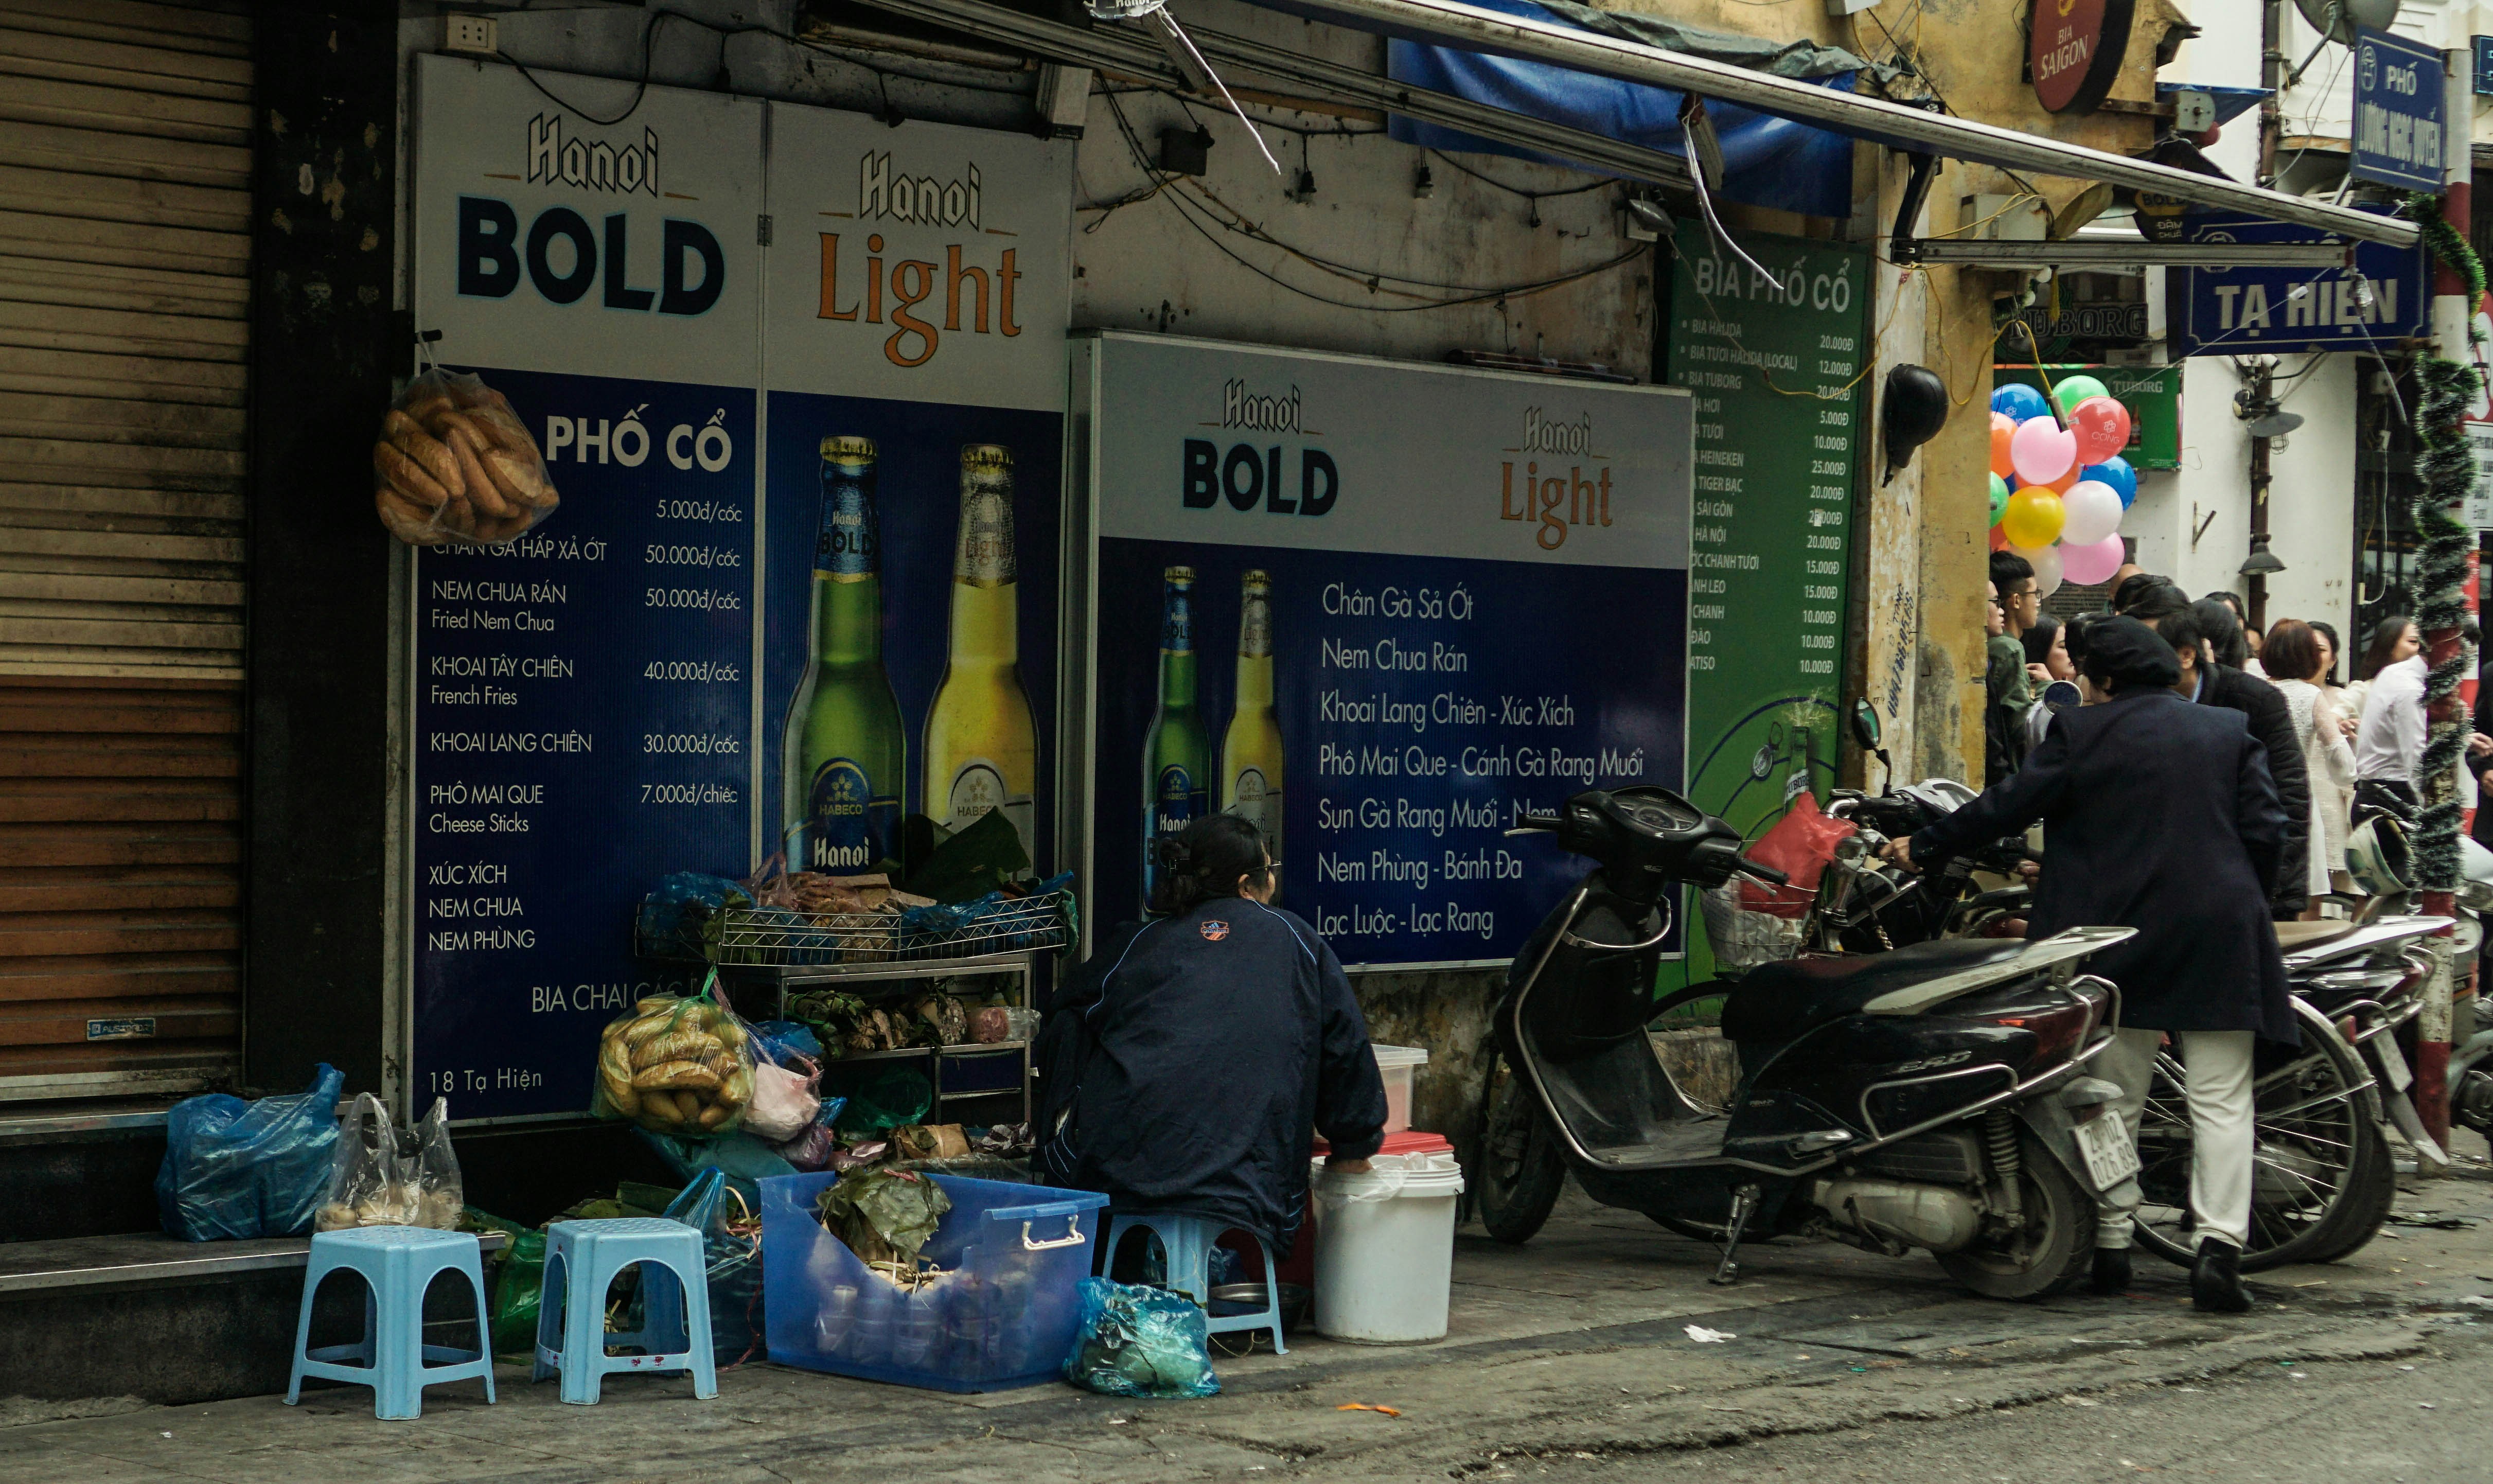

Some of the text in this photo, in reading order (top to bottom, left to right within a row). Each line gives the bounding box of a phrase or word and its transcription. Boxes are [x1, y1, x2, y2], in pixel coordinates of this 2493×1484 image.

[2058, 25, 2072, 45] BIA
[2041, 34, 2089, 80] SAIGON
[2385, 62, 2417, 95] PHỐ
[528, 112, 658, 198] Hanoi
[860, 149, 981, 232] Hanoi
[458, 196, 724, 315] BOLD
[1698, 256, 1850, 313] BIA PHỐ CỔ
[817, 232, 1022, 367] Light
[2215, 269, 2397, 337] TẠ HIỆN
[1692, 319, 1741, 337] BIA HALIDA
[1820, 335, 1853, 351] 20.000Đ
[1690, 345, 1705, 360] BIA
[1764, 352, 1797, 372] (LOCAL)
[1819, 360, 1852, 376] 12.000Đ
[1689, 371, 1741, 390] BIA TUBORG
[2113, 381, 2163, 392] TUBORG
[1224, 378, 1300, 434] Hanoi
[1820, 411, 1848, 426] 5.000Đ
[546, 404, 732, 472] PHỐ CỔ
[1524, 407, 1590, 457] Hanoi
[1815, 435, 1847, 451] 10.000Đ
[1701, 450, 1744, 467] HEINEKEN
[1812, 460, 1846, 475] 25.000Đ
[1183, 439, 1338, 516] BOLD
[1698, 476, 1743, 496] TIGER BẠC
[1811, 485, 1844, 500] 20.000Đ
[656, 499, 742, 523] 5.000đ/cốc
[1501, 462, 1613, 550] Light
[1697, 499, 1733, 517] SÀI GÒN
[522, 533, 607, 560] HẤP XẢ ỚT
[822, 531, 873, 555] BOLD
[1695, 525, 1726, 546] HÀ NỘI
[1807, 536, 1841, 550] 20.000Đ
[645, 545, 740, 568] 50.000đ/cốc
[1705, 553, 1737, 569] CHANH
[1806, 560, 1840, 575] 15.000Đ
[433, 579, 565, 603] NEM CHUA RÁN
[1709, 579, 1726, 593] LEO
[1805, 585, 1837, 599] 15.000Đ
[645, 588, 740, 611] 50.000đ/cốc
[1323, 581, 1473, 620] Chân Gà Sả Ớt
[433, 609, 554, 631] Fried Nem Chua
[1693, 605, 1724, 619] CHANH
[1803, 610, 1836, 624] 10.000Đ
[1690, 627, 1711, 644] ĐÀO
[1801, 635, 1834, 648] 10.000Đ
[432, 653, 572, 678] KHOAI TÂY CHIÊN
[1323, 638, 1466, 672] Nem Chua Rán
[1690, 656, 1715, 670] ATISO
[644, 661, 738, 683] 40.000đ/cốc
[1800, 660, 1833, 674] 10.000Đ
[432, 685, 517, 705] French Fries
[1322, 689, 1573, 732] Khoai Lang Chiên Xúc Xích
[431, 729, 591, 753] KHOAI LANG CHIÊN
[644, 734, 738, 756] 30.000đ/cốc
[1320, 742, 1643, 785] Phô Mai Que Cánh Gà Rang Muối
[430, 781, 543, 805] PHÔ MAI QUE
[642, 783, 737, 806] 7.000đ/chiếc
[819, 804, 862, 815] HABECO
[958, 806, 990, 816] HABEC
[1319, 798, 1353, 833] Sụn
[1360, 798, 1390, 828] Gà
[1398, 799, 1444, 837] Rang
[1451, 798, 1497, 828] Muối
[430, 812, 528, 833] Cheese Sticks
[814, 837, 869, 867] Hanoi
[430, 860, 506, 885] XÚC XÍCH
[1319, 848, 1522, 889] Nem Phùng Bánh Đa
[429, 897, 523, 918] NEM CHUA
[1317, 902, 1493, 941] Lạc Luộc Lạc Rang
[429, 926, 535, 951] NEM PHÙNG
[533, 984, 567, 1013] BIA
[573, 984, 627, 1011] CHAI
[1886, 1050, 1972, 1074] EAD
[430, 1068, 541, 1094] 18 Tạ Hiện
